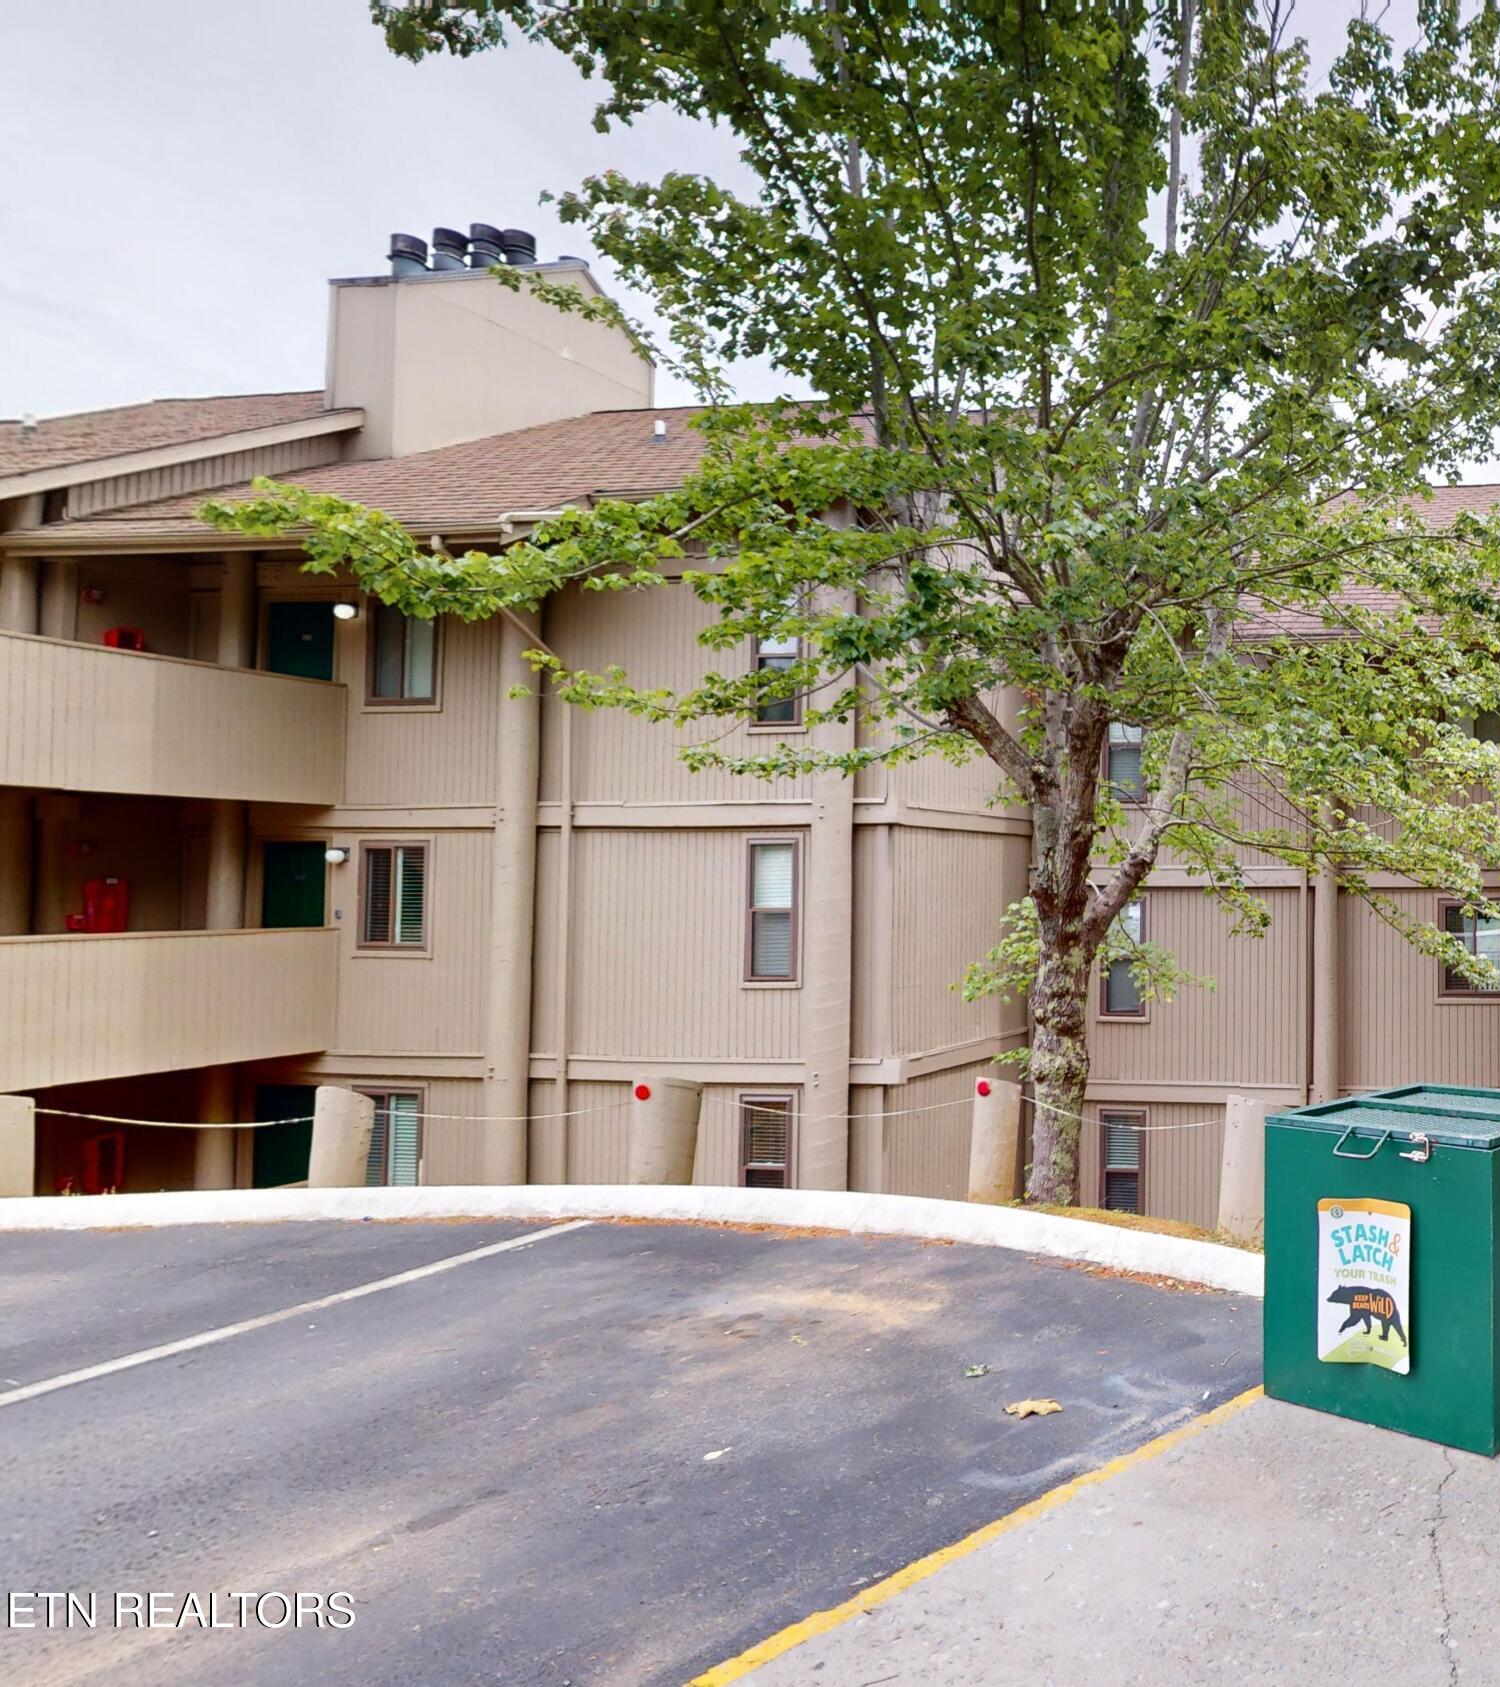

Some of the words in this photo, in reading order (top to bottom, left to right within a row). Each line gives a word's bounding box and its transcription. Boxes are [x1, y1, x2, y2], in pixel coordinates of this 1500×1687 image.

[1330, 1223, 1389, 1248] STASH
[1388, 1233, 1400, 1257] &
[1338, 1244, 1394, 1272] LATCH
[1334, 1268, 1365, 1279] YOUR
[1368, 1270, 1397, 1287] TRASH
[1352, 1301, 1370, 1309] BEARS
